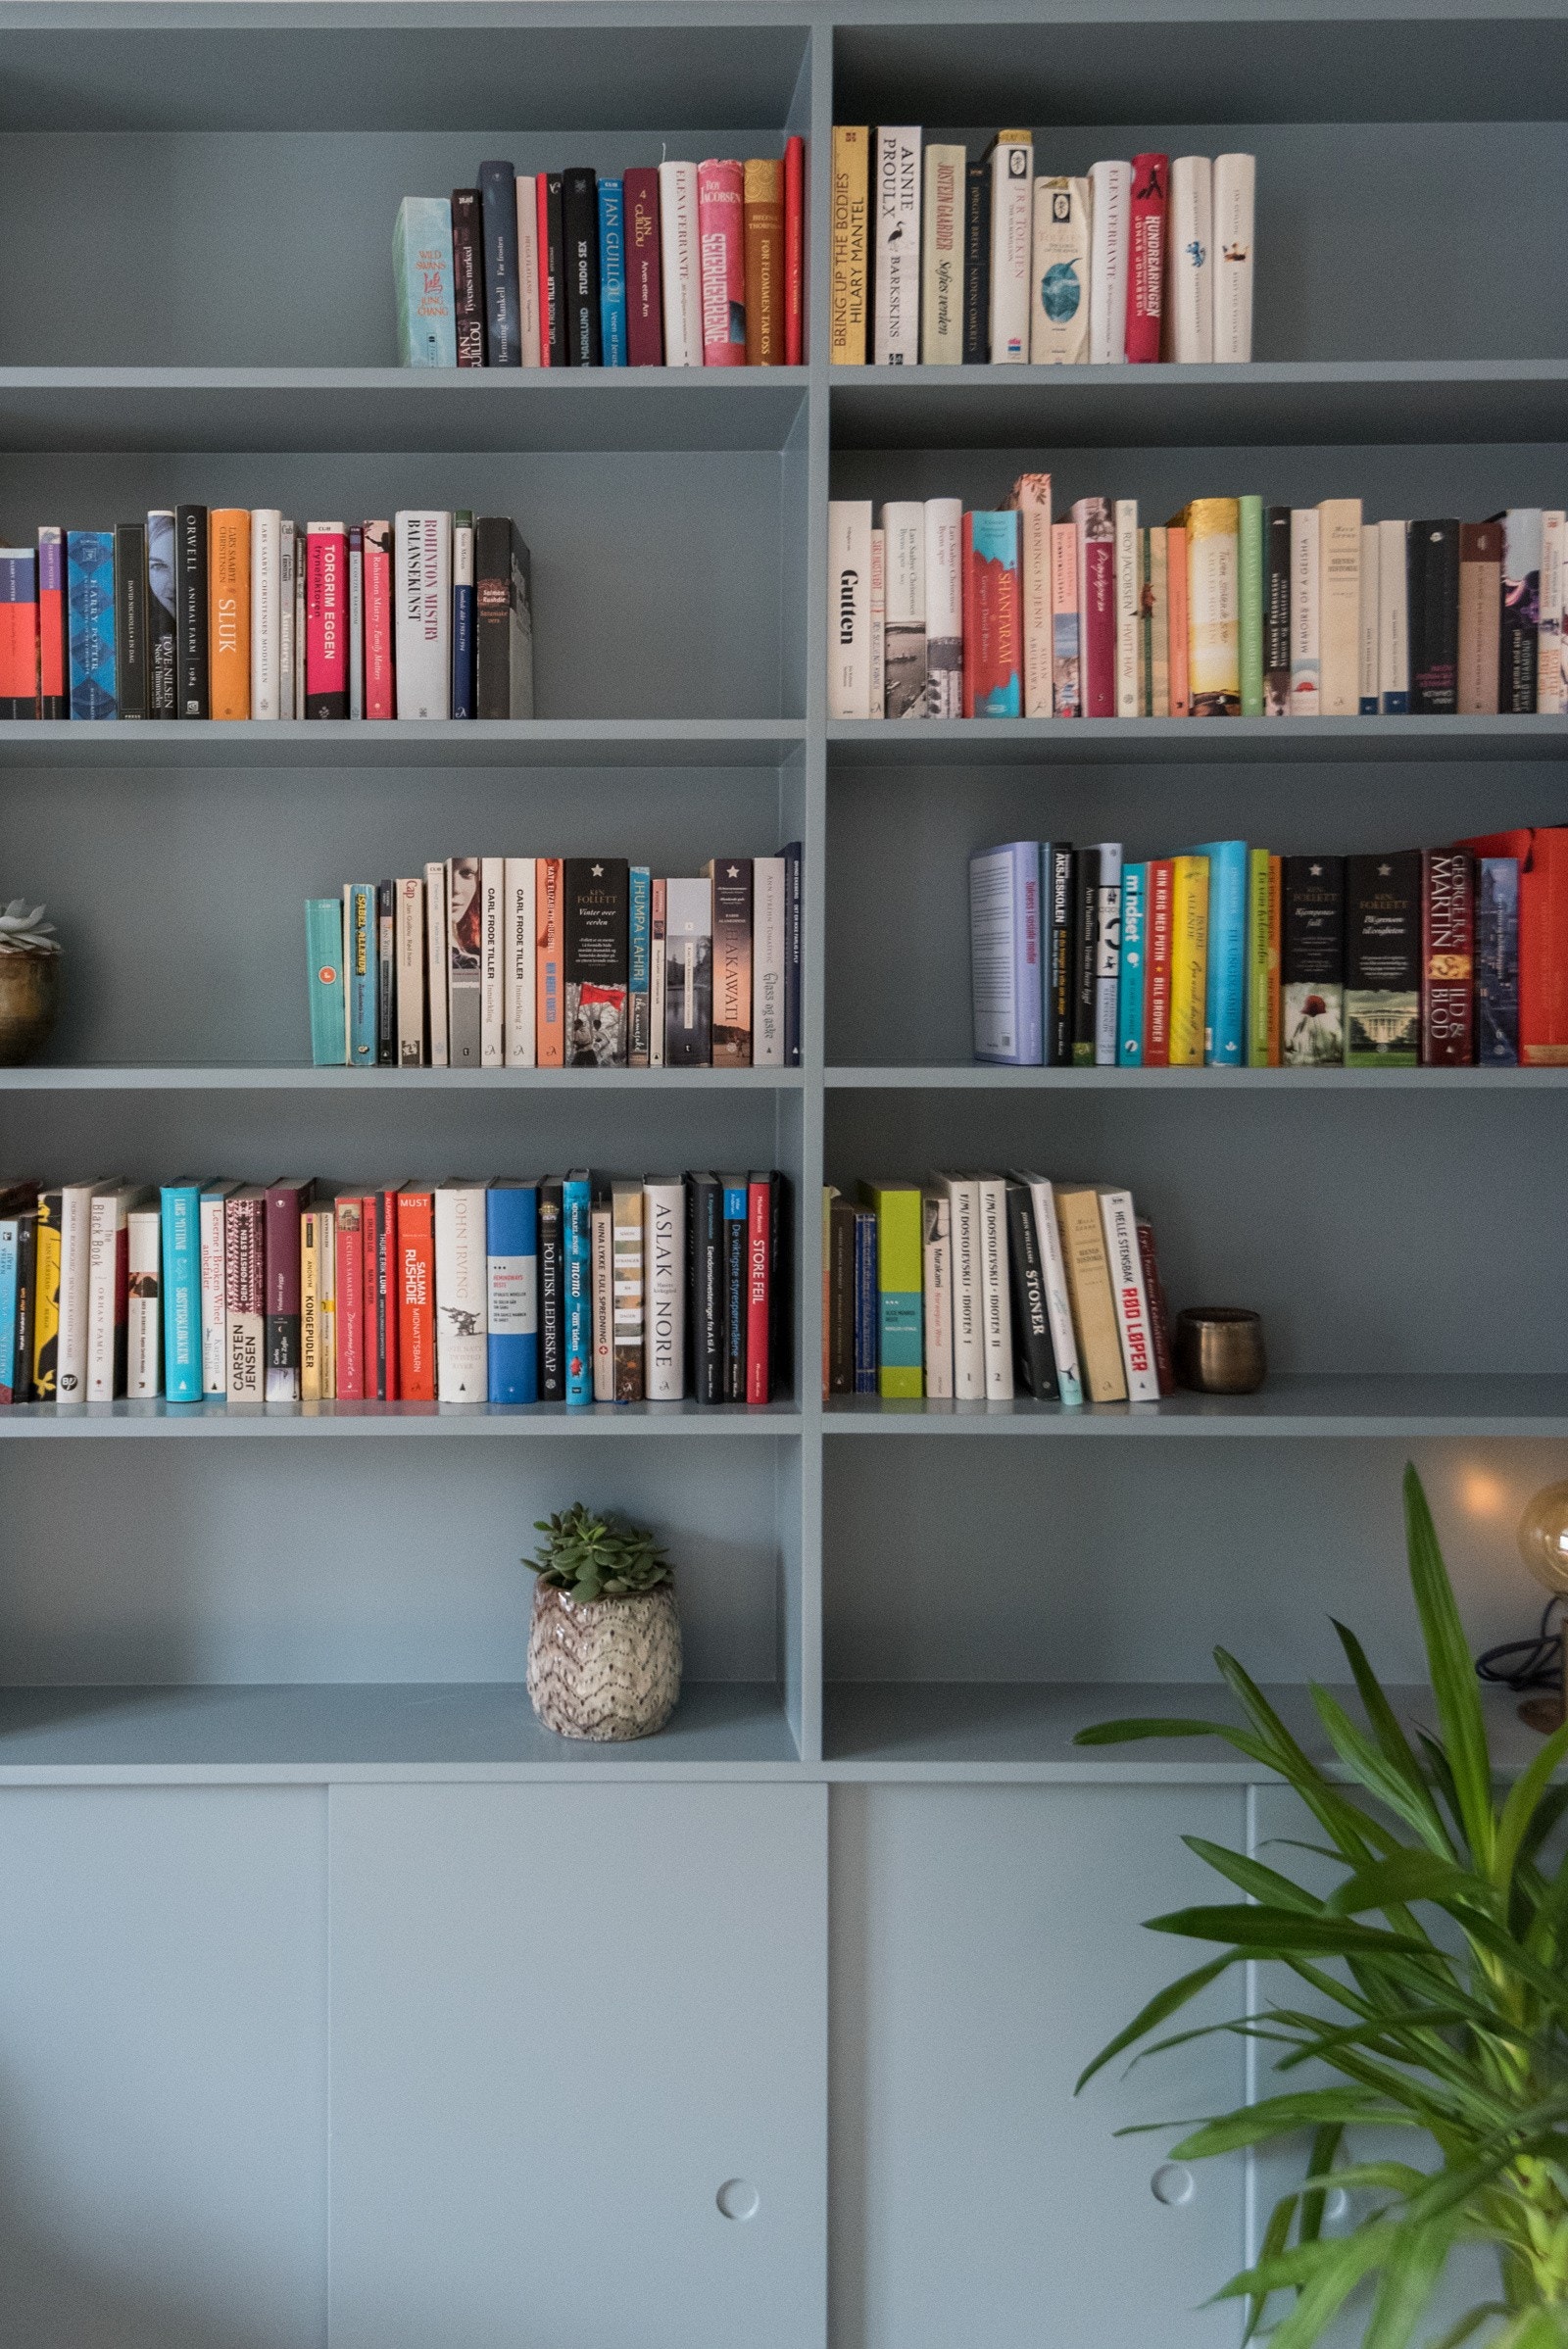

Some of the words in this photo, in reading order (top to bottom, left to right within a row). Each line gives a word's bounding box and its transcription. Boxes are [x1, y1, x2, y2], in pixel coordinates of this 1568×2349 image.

[676, 171, 687, 211] ELENA
[700, 187, 741, 203] JACOBSEN
[883, 138, 896, 219] PROULX
[901, 147, 913, 211] ANNIE
[937, 163, 954, 204] JOSTEIN
[604, 198, 617, 225] JAN
[836, 173, 849, 229] BODIES
[635, 205, 644, 248] GUILLOU
[677, 215, 689, 277] FERRANTE
[852, 197, 863, 261] MANTEL
[936, 207, 954, 250] GAARDER
[464, 247, 472, 277] marked
[578, 241, 587, 258] SEX
[607, 233, 619, 303] GUILLOU
[836, 235, 848, 266] THE
[465, 279, 474, 312] Tyvenes
[579, 261, 588, 295] STUDIO
[761, 263, 770, 312] FLOMMEN
[836, 272, 847, 291] UP
[851, 268, 863, 322] HILARY
[890, 257, 901, 338] BARKSKINS
[939, 260, 952, 292] Sofies
[417, 307, 448, 316] CHANG
[496, 287, 506, 321] Mankell
[761, 313, 770, 335] TAR
[835, 299, 847, 346] BRING
[938, 295, 951, 335] verden
[461, 336, 469, 359] JAN
[499, 324, 508, 363] Henning
[579, 308, 589, 355] MARKLUND
[761, 335, 770, 355] OSS
[186, 515, 197, 572] ORWELL
[425, 519, 437, 588] ROHINTON
[324, 545, 334, 608] TORGRIM
[408, 519, 420, 621] BALANSEKUNST
[1034, 580, 1042, 591] IN
[1122, 554, 1131, 610] JACOBSEN
[372, 598, 381, 623] Mistry
[425, 594, 437, 642] MISTRY
[840, 569, 858, 645] Gutten
[999, 574, 1011, 664] SHANTARAM
[1300, 591, 1308, 604] OF
[219, 599, 236, 653] SLUK
[324, 612, 334, 660] EGGEN
[372, 629, 382, 654] Family
[163, 634, 172, 664] TOVE
[373, 655, 382, 680] Matters
[163, 668, 173, 708] NILSEN
[404, 880, 417, 899] Cap
[1054, 853, 1065, 924] AKSJESKOLEN
[1156, 869, 1168, 888] MIN
[1452, 856, 1466, 915] GEORGE
[516, 889, 525, 913] CARL
[633, 879, 646, 934] JHUMPA
[1126, 875, 1143, 942] mindset
[1156, 892, 1167, 912] KRIG
[1431, 856, 1452, 947] MARTIN
[516, 915, 525, 945] FRODE
[1155, 915, 1167, 932] MED
[633, 937, 645, 981] LAHIRI
[1154, 934, 1166, 961] PUTIN
[725, 929, 737, 1022] HAKAWATI
[1153, 977, 1164, 998] BILL
[1152, 999, 1164, 1043] BROWDER
[1431, 988, 1448, 1039] BLOD
[1449, 988, 1464, 1014] ILD
[1450, 1023, 1464, 1036] &
[93, 1204, 104, 1236] Black
[454, 1198, 467, 1239] JOHN
[731, 1225, 741, 1237] De
[986, 1194, 998, 1286] F/M/DOSTOJEVSKIJ
[1114, 1210, 1126, 1239] HELLE
[91, 1241, 104, 1266] Book
[656, 1204, 672, 1277] ASLAK
[730, 1239, 741, 1276] viktigste
[753, 1240, 764, 1279] STORE
[960, 1194, 971, 1287] F/M/DOSTOJEVSKIJ
[1117, 1238, 1134, 1284] STENSBAK
[203, 1245, 212, 1290] anbefaler
[405, 1249, 416, 1304] RUSHDIE
[416, 1261, 426, 1305] SALMAN
[455, 1246, 468, 1299] IRVING
[544, 1243, 555, 1297] POLITISK
[571, 1261, 580, 1297] momo
[753, 1281, 764, 1304] FEIL
[1025, 1270, 1045, 1335] STONER
[1122, 1287, 1141, 1319] RØD
[306, 1295, 315, 1368] KONGEPUDLER
[545, 1298, 557, 1372] LEDERSKAP
[572, 1312, 580, 1327] om
[599, 1297, 608, 1344] SPREDNING
[656, 1302, 672, 1367] NORE
[730, 1279, 741, 1356] styrespørsmålene
[962, 1295, 972, 1335] IDIOTEN
[990, 1295, 1000, 1335] IDIOTEN
[233, 1325, 243, 1391] CARSTEN
[413, 1308, 421, 1373] MIDNATTSBARN
[572, 1328, 581, 1351] tiden
[1126, 1323, 1148, 1372] LØPER
[245, 1336, 256, 1391] JENSEN
